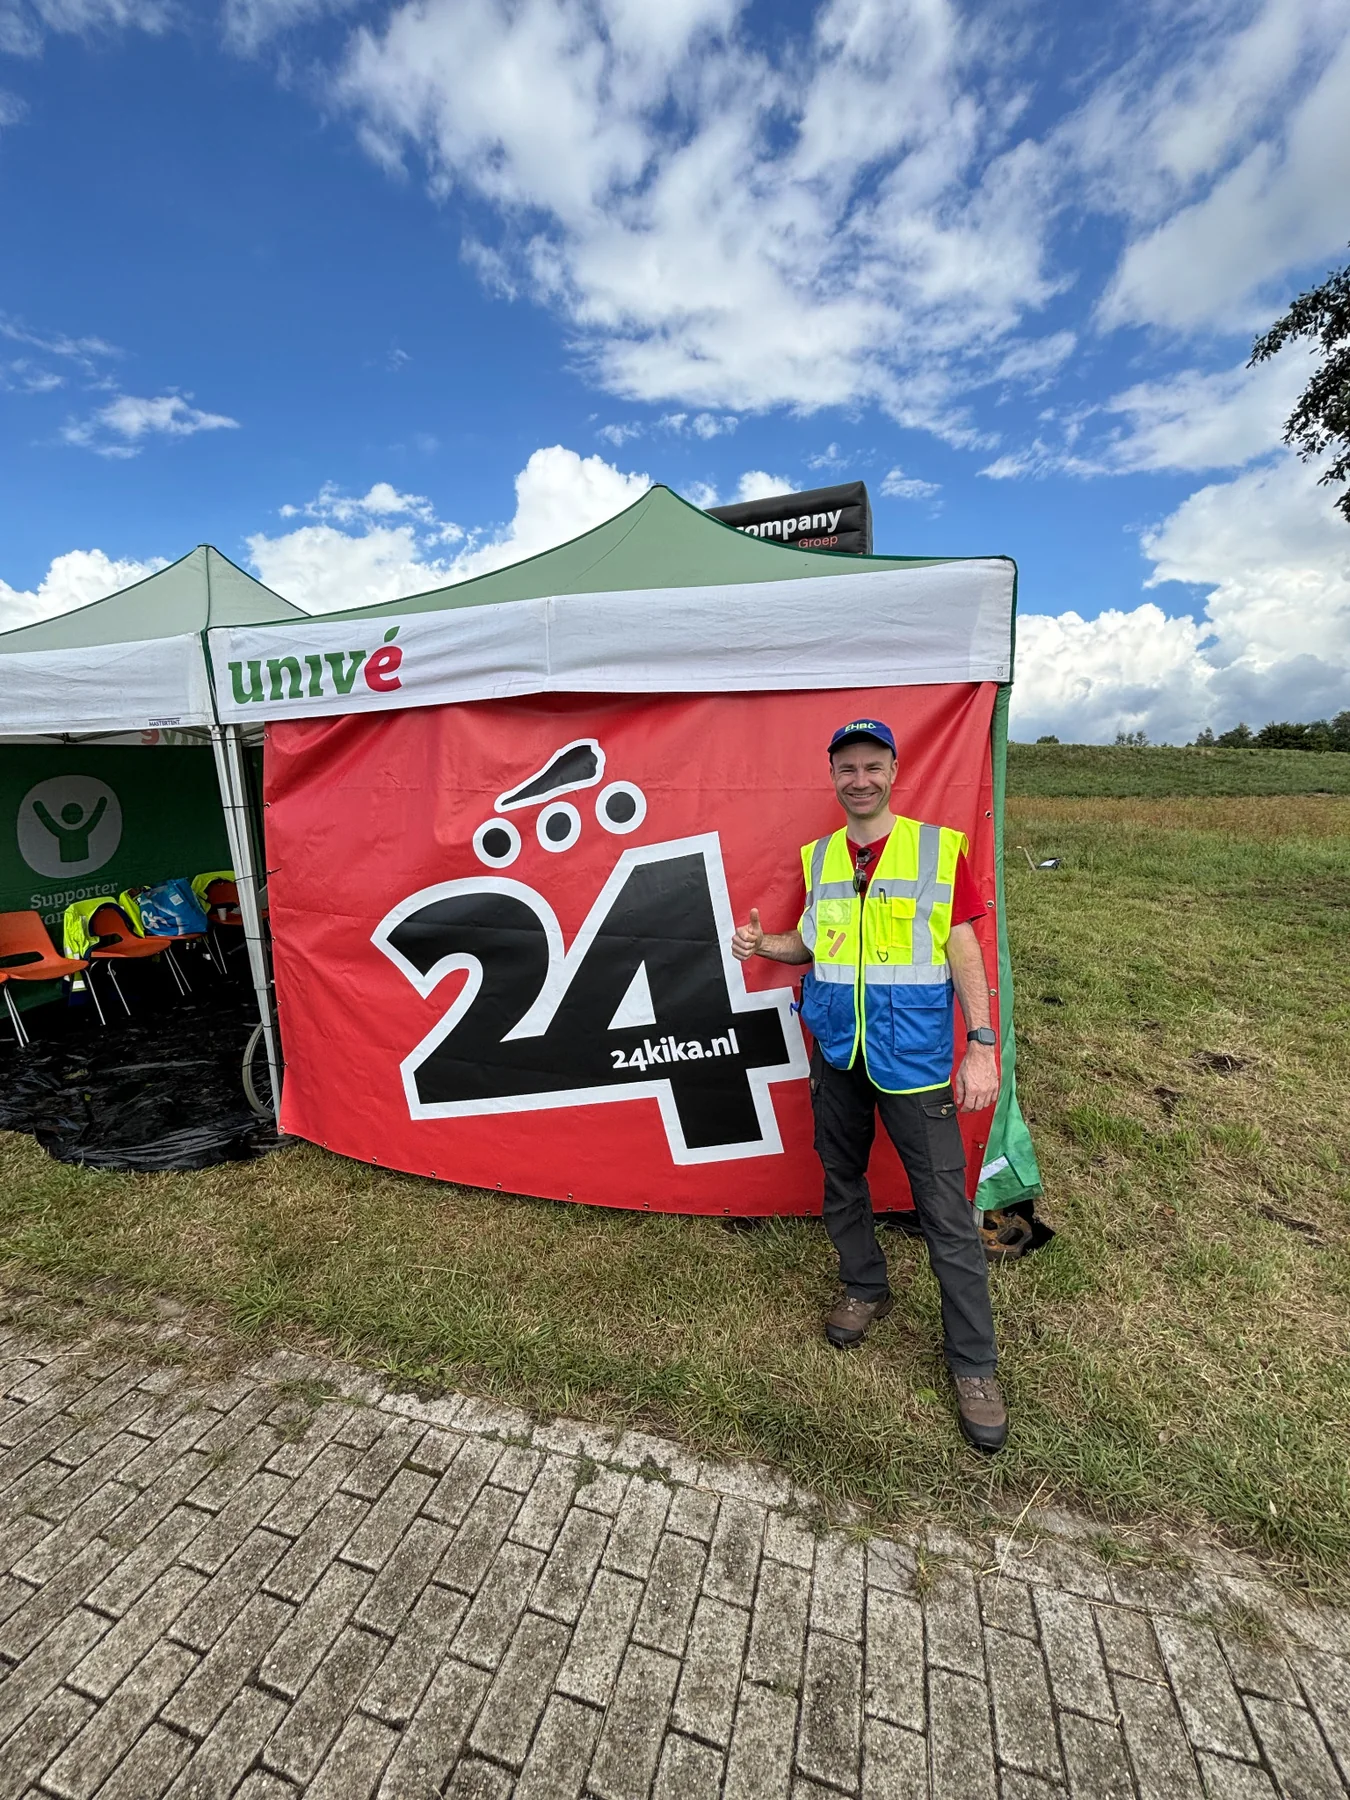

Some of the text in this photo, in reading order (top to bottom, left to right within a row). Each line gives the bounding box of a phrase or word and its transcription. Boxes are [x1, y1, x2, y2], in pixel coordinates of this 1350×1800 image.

[798, 535, 838, 548] Groep
[30, 882, 118, 909] Supporter
[370, 831, 810, 1166] 24
[610, 1028, 740, 1071] 24kika.nl
